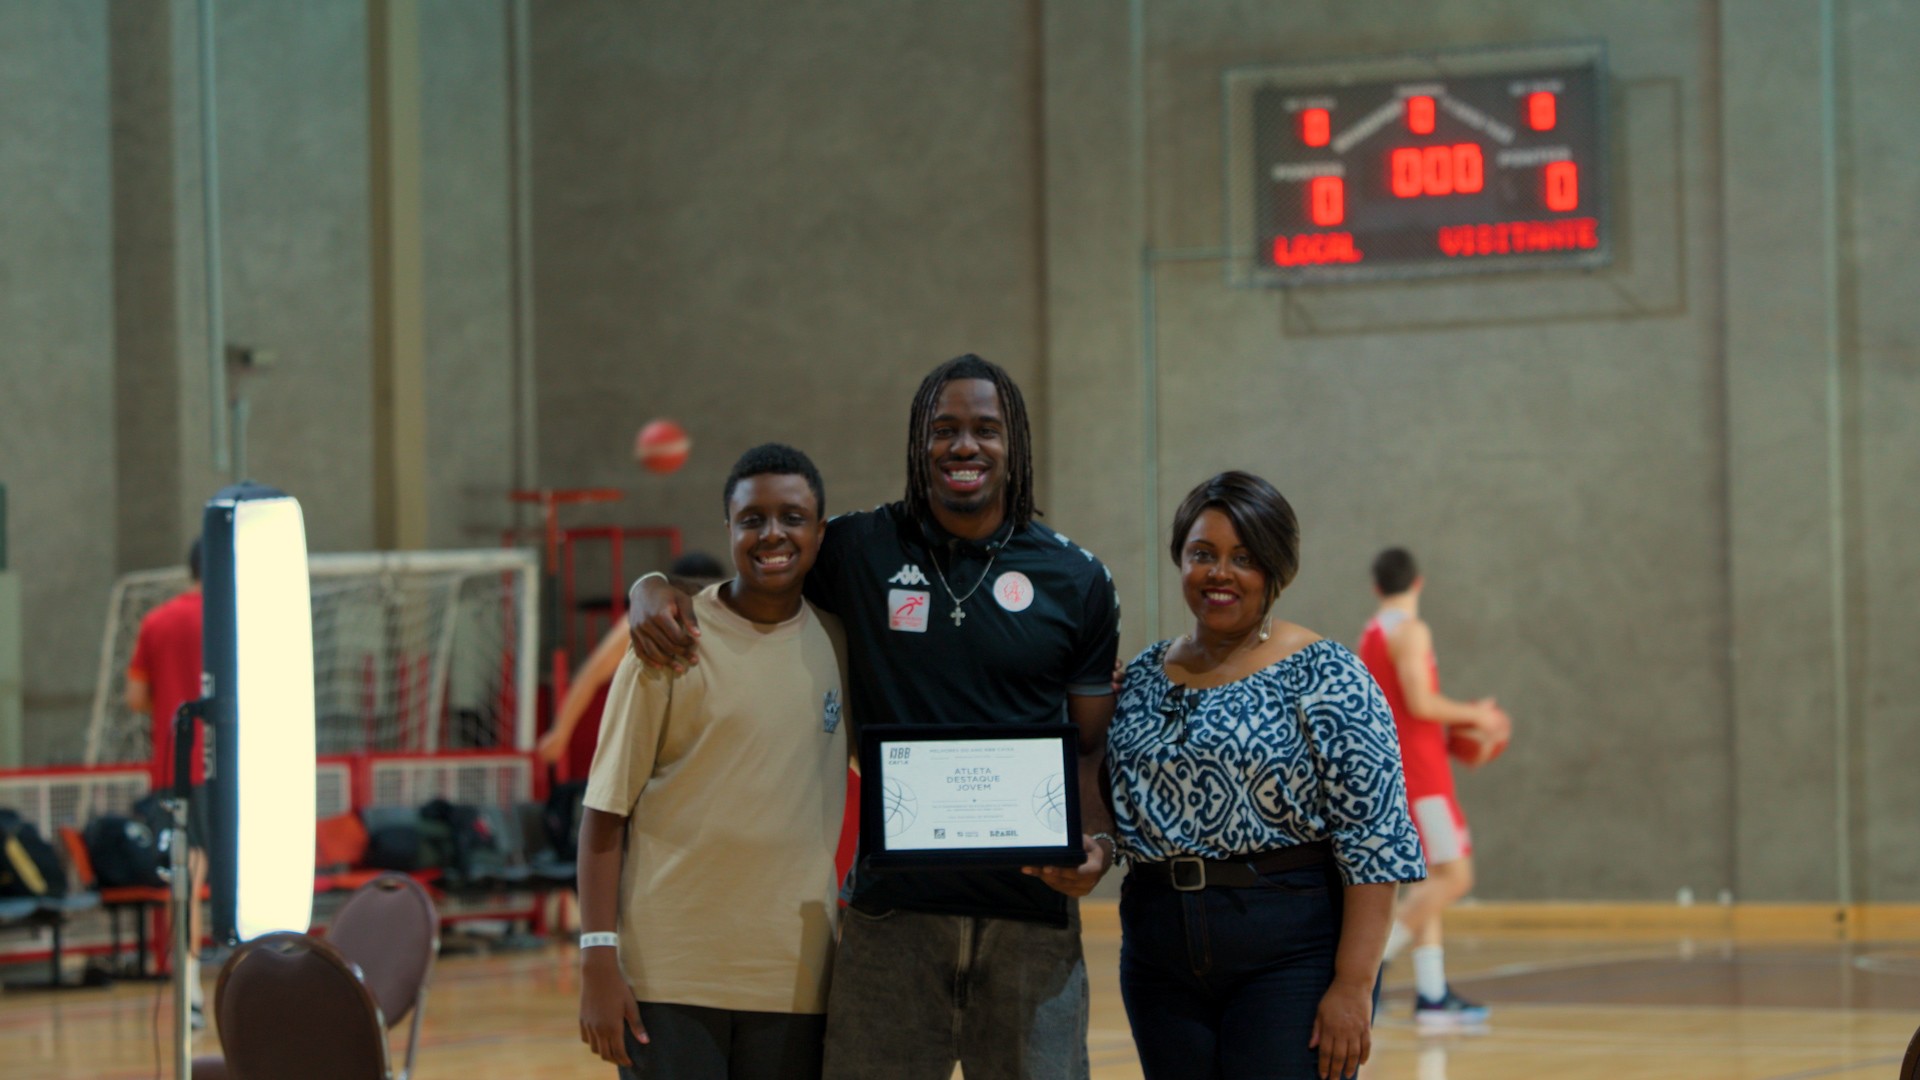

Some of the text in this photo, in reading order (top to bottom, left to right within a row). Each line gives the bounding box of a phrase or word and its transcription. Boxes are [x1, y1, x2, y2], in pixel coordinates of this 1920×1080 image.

[1311, 175, 1344, 227] 0
[1545, 160, 1579, 212] 0
[1273, 231, 1364, 267] LOCAL
[1438, 216, 1599, 258] VISITANTE
[946, 775, 1001, 784] DESTAQUE
[954, 767, 992, 775] ATLETA
[956, 784, 992, 792] JOVEM
